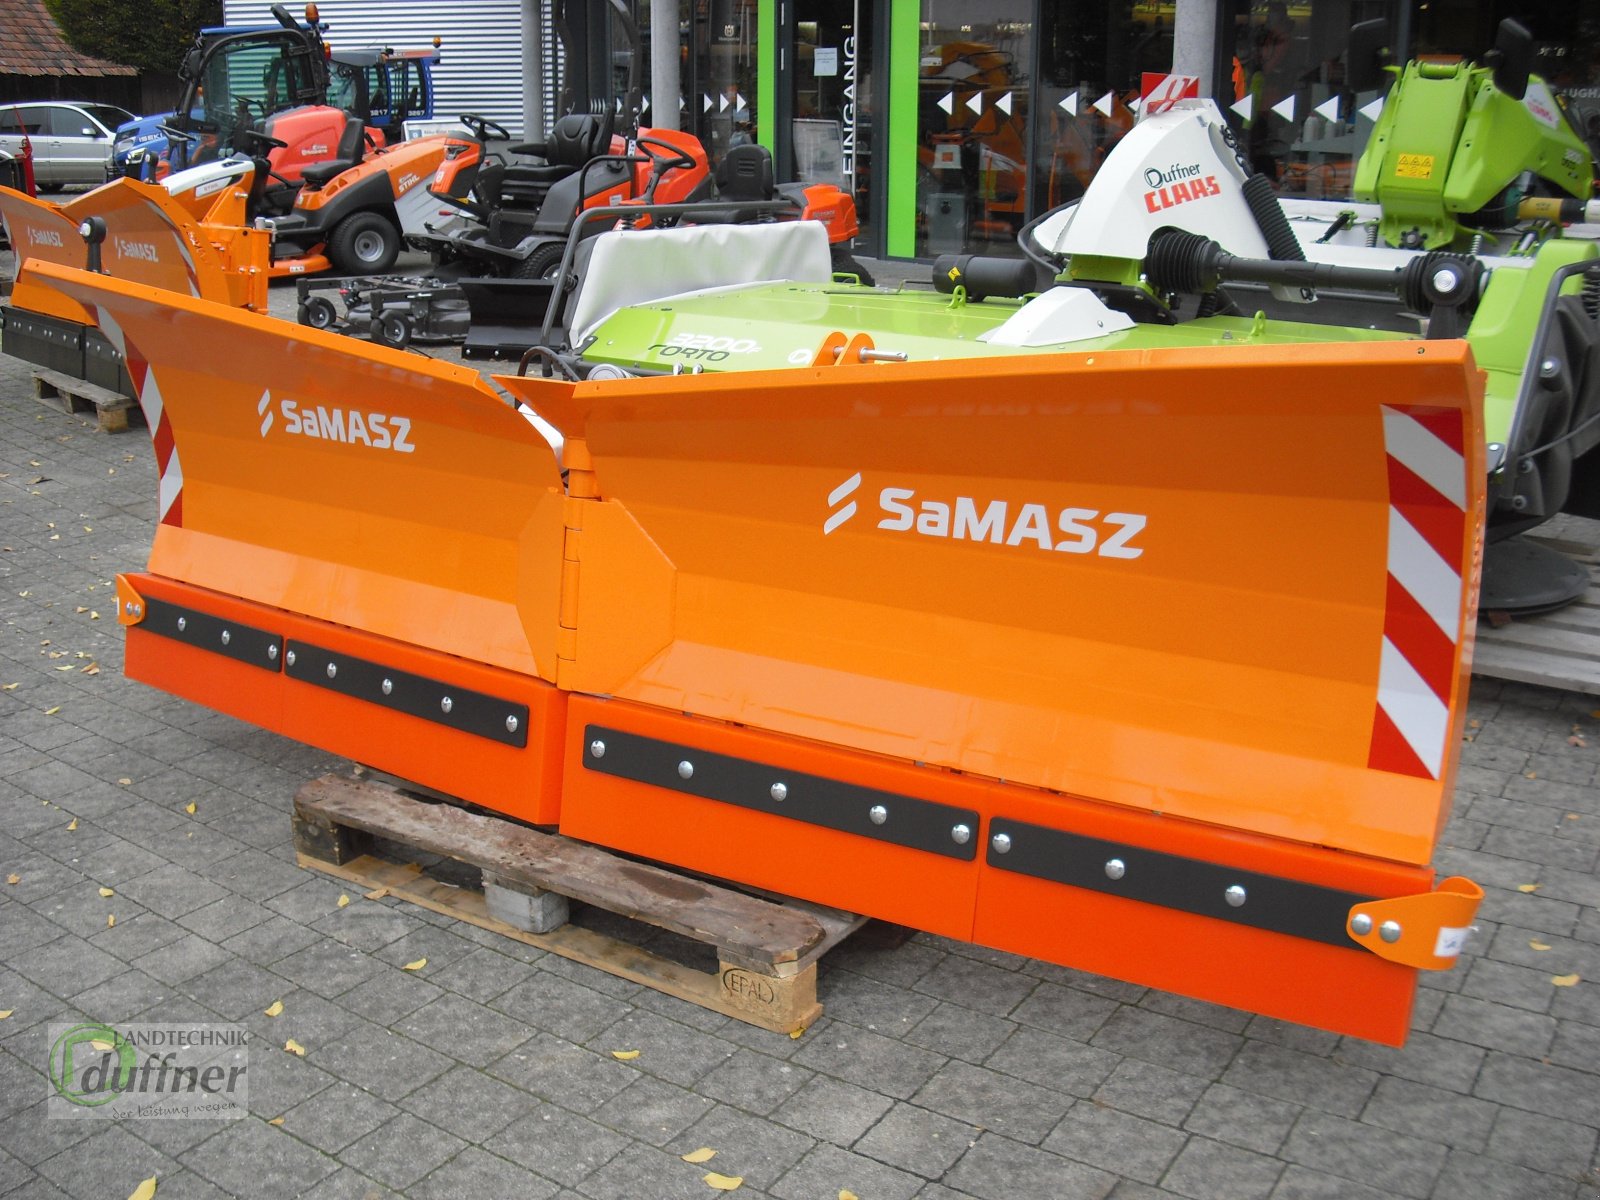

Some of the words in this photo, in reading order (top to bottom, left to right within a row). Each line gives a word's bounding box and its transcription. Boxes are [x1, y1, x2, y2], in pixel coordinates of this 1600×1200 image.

[843, 36, 855, 175] EINGANG
[398, 175, 420, 193] STIHL
[1144, 163, 1200, 188] Duffner
[1144, 176, 1220, 214] CLAAS
[32, 229, 63, 247] SaMASZ
[121, 240, 158, 262] SaMASZ
[281, 400, 416, 454] SaMASZ
[877, 487, 1147, 560] SaMASZ
[731, 973, 767, 1003] EPAL
